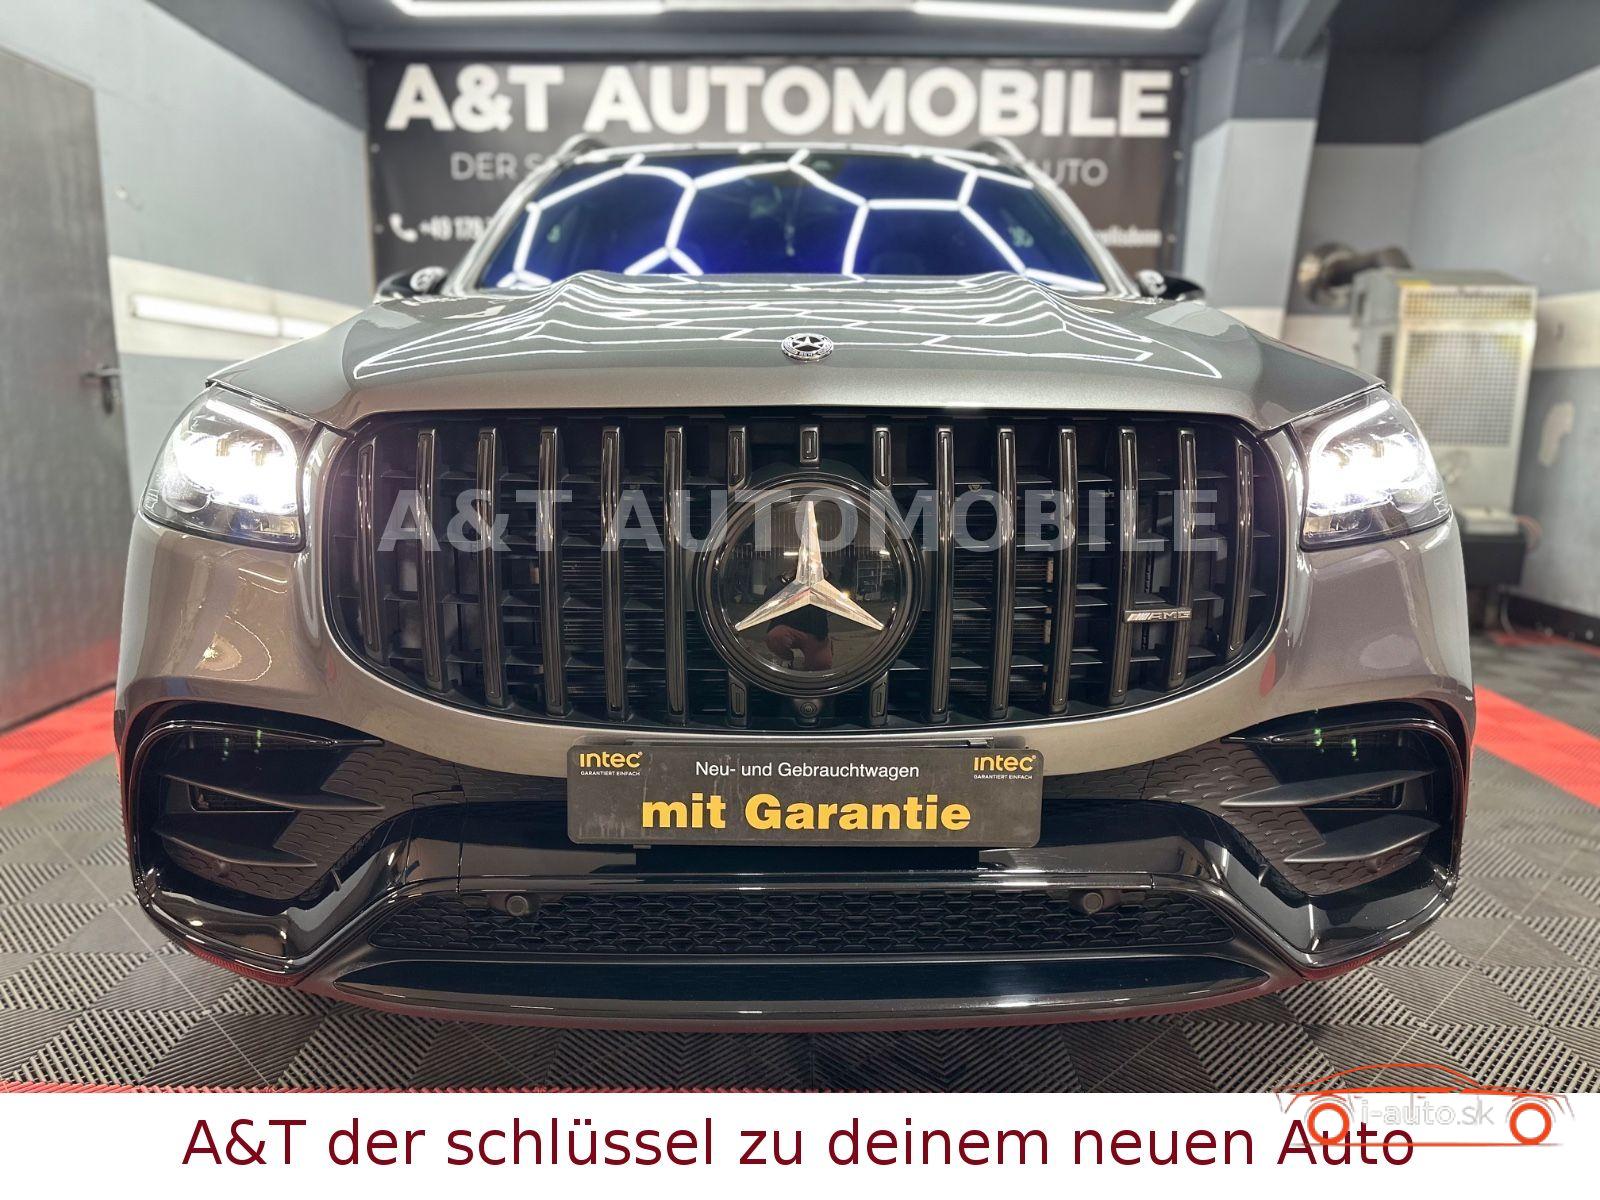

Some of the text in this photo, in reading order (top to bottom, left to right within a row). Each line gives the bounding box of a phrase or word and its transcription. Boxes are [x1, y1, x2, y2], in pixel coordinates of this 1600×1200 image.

[386, 63, 1173, 137] A&T AUTOMOBILE
[450, 151, 518, 181] DER
[695, 761, 920, 780] Neu- und Gebrauchtwagen
[642, 792, 971, 830] mit Garantie
